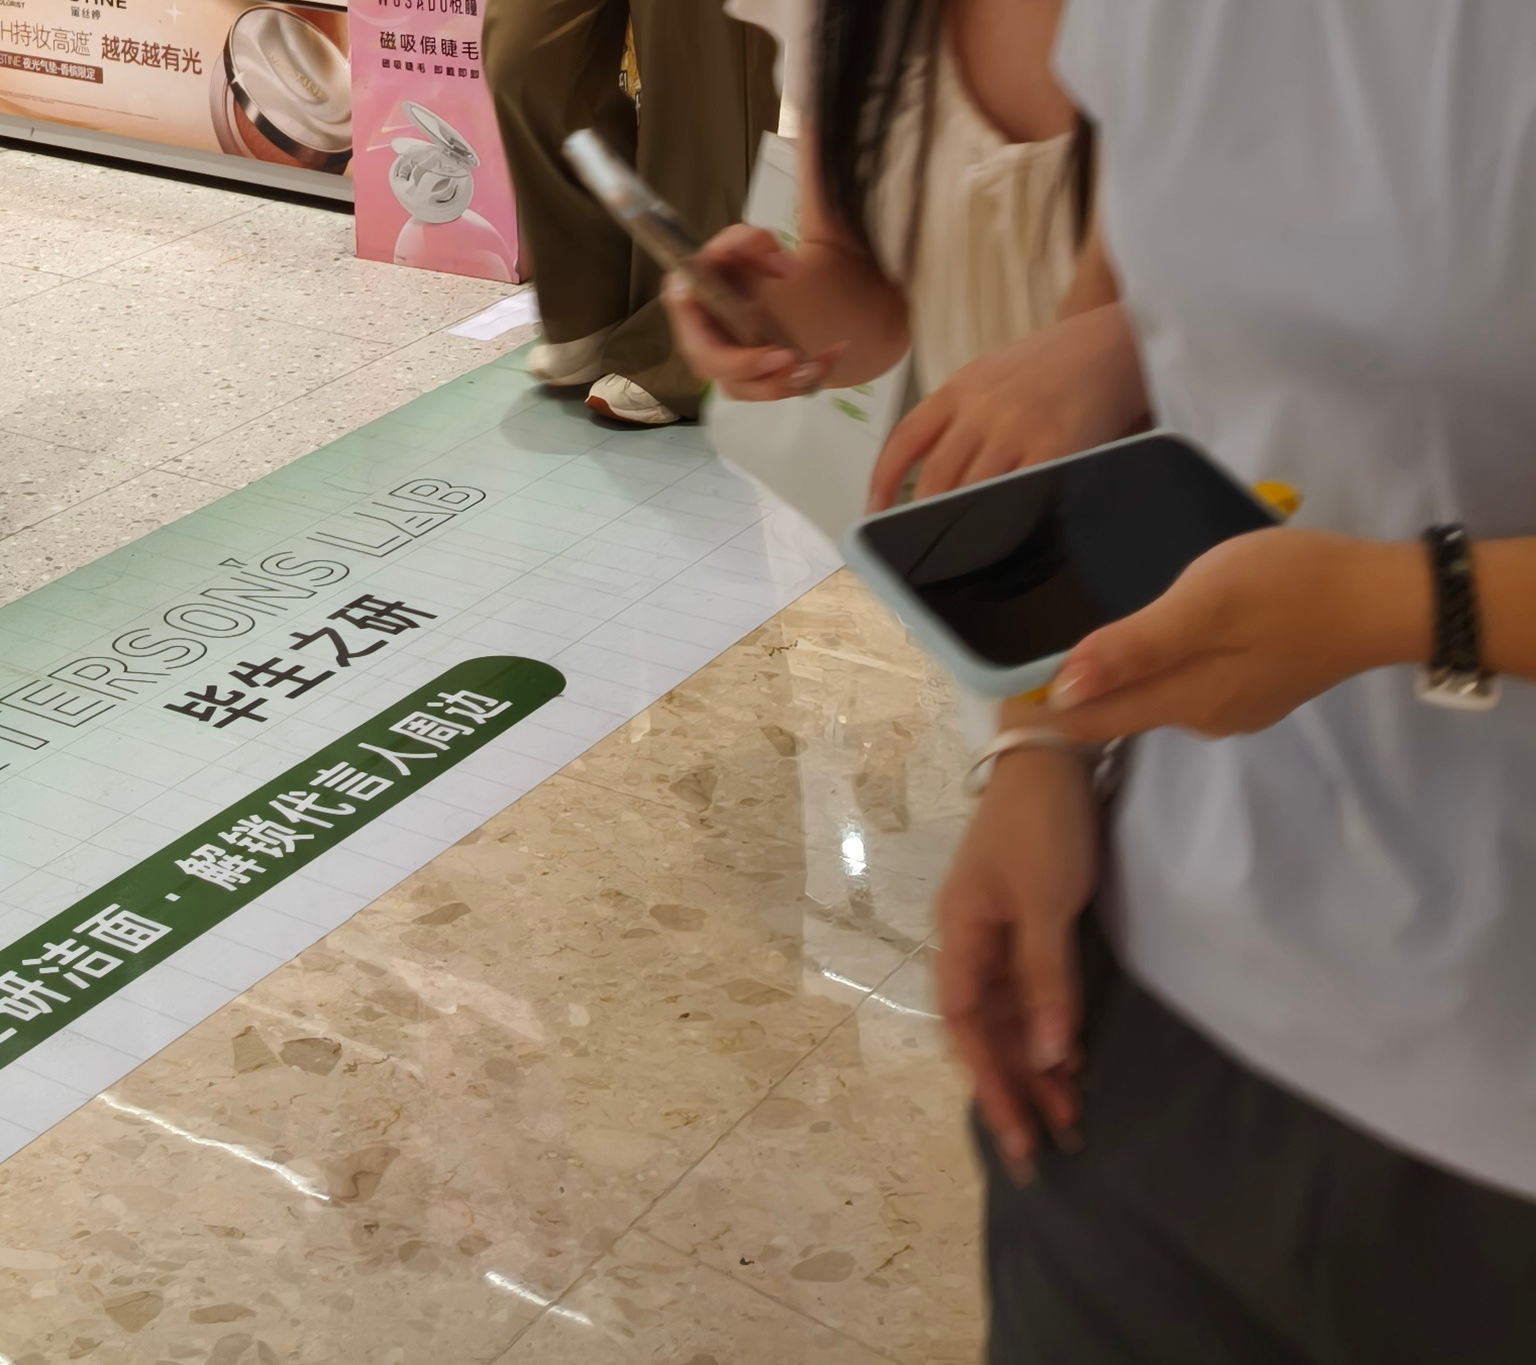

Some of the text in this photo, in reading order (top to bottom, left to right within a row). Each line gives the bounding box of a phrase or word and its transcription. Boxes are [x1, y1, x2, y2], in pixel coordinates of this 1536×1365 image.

[101, 33, 204, 76] 越夜越有光
[380, 31, 480, 61] 磁吸假睫毛
[307, 477, 487, 558] LAB
[164, 594, 438, 730] 毕生之研
